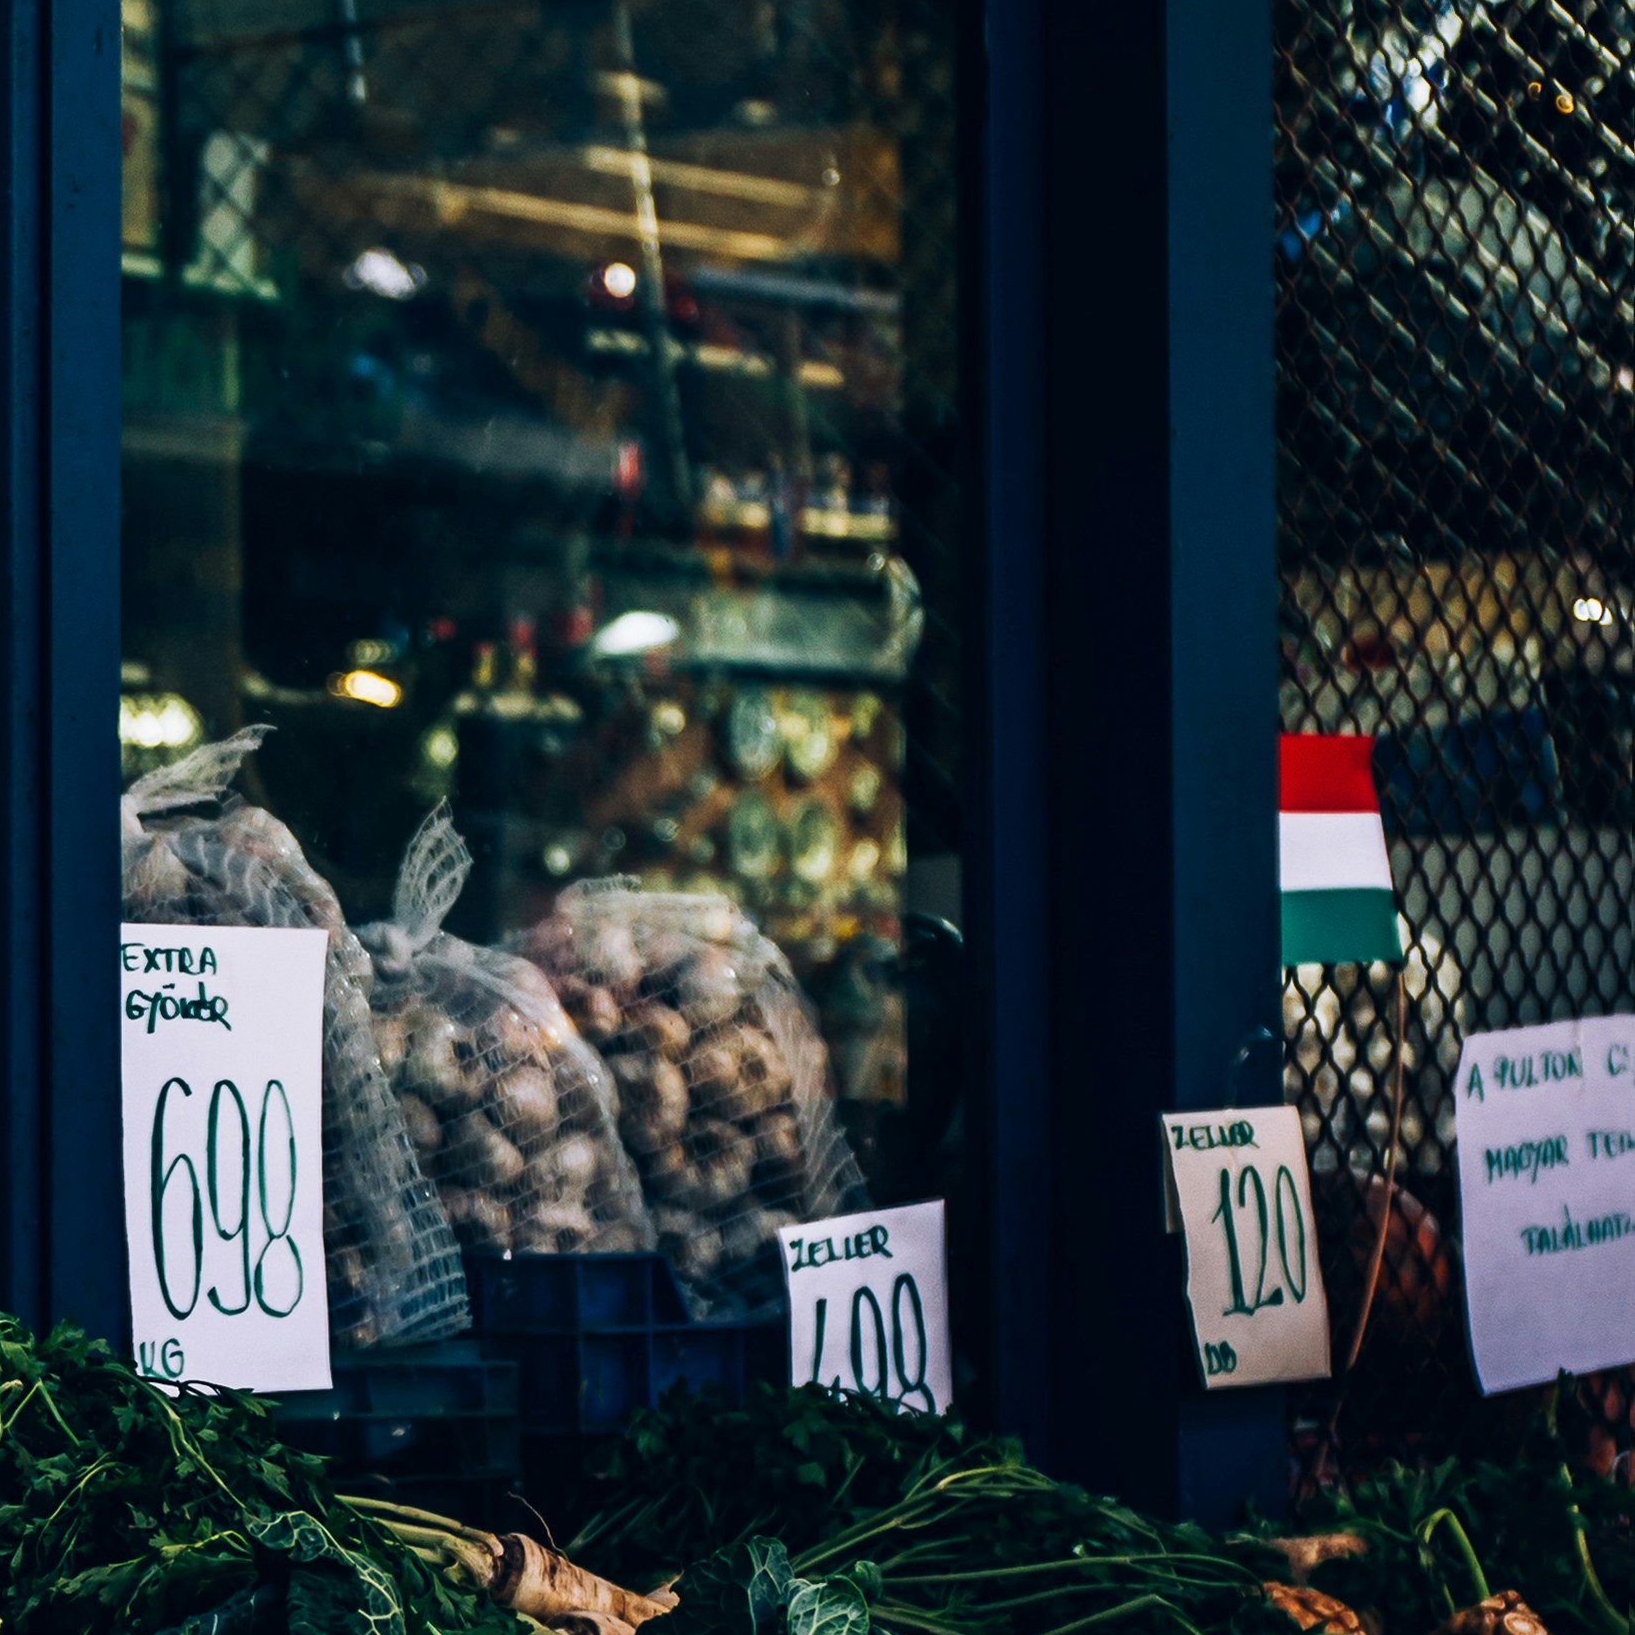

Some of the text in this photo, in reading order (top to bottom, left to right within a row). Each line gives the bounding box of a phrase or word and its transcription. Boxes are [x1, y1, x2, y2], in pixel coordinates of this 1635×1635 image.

[121, 943, 217, 976] EXTRA
[1467, 1062, 1485, 1102] A
[1492, 1047, 1583, 1089] PULTON
[150, 1076, 304, 1321] 698
[789, 1224, 894, 1272] ZELLER
[1211, 1164, 1306, 1317] 120
[138, 1336, 185, 1379] KG
[1203, 1340, 1237, 1376] DB
